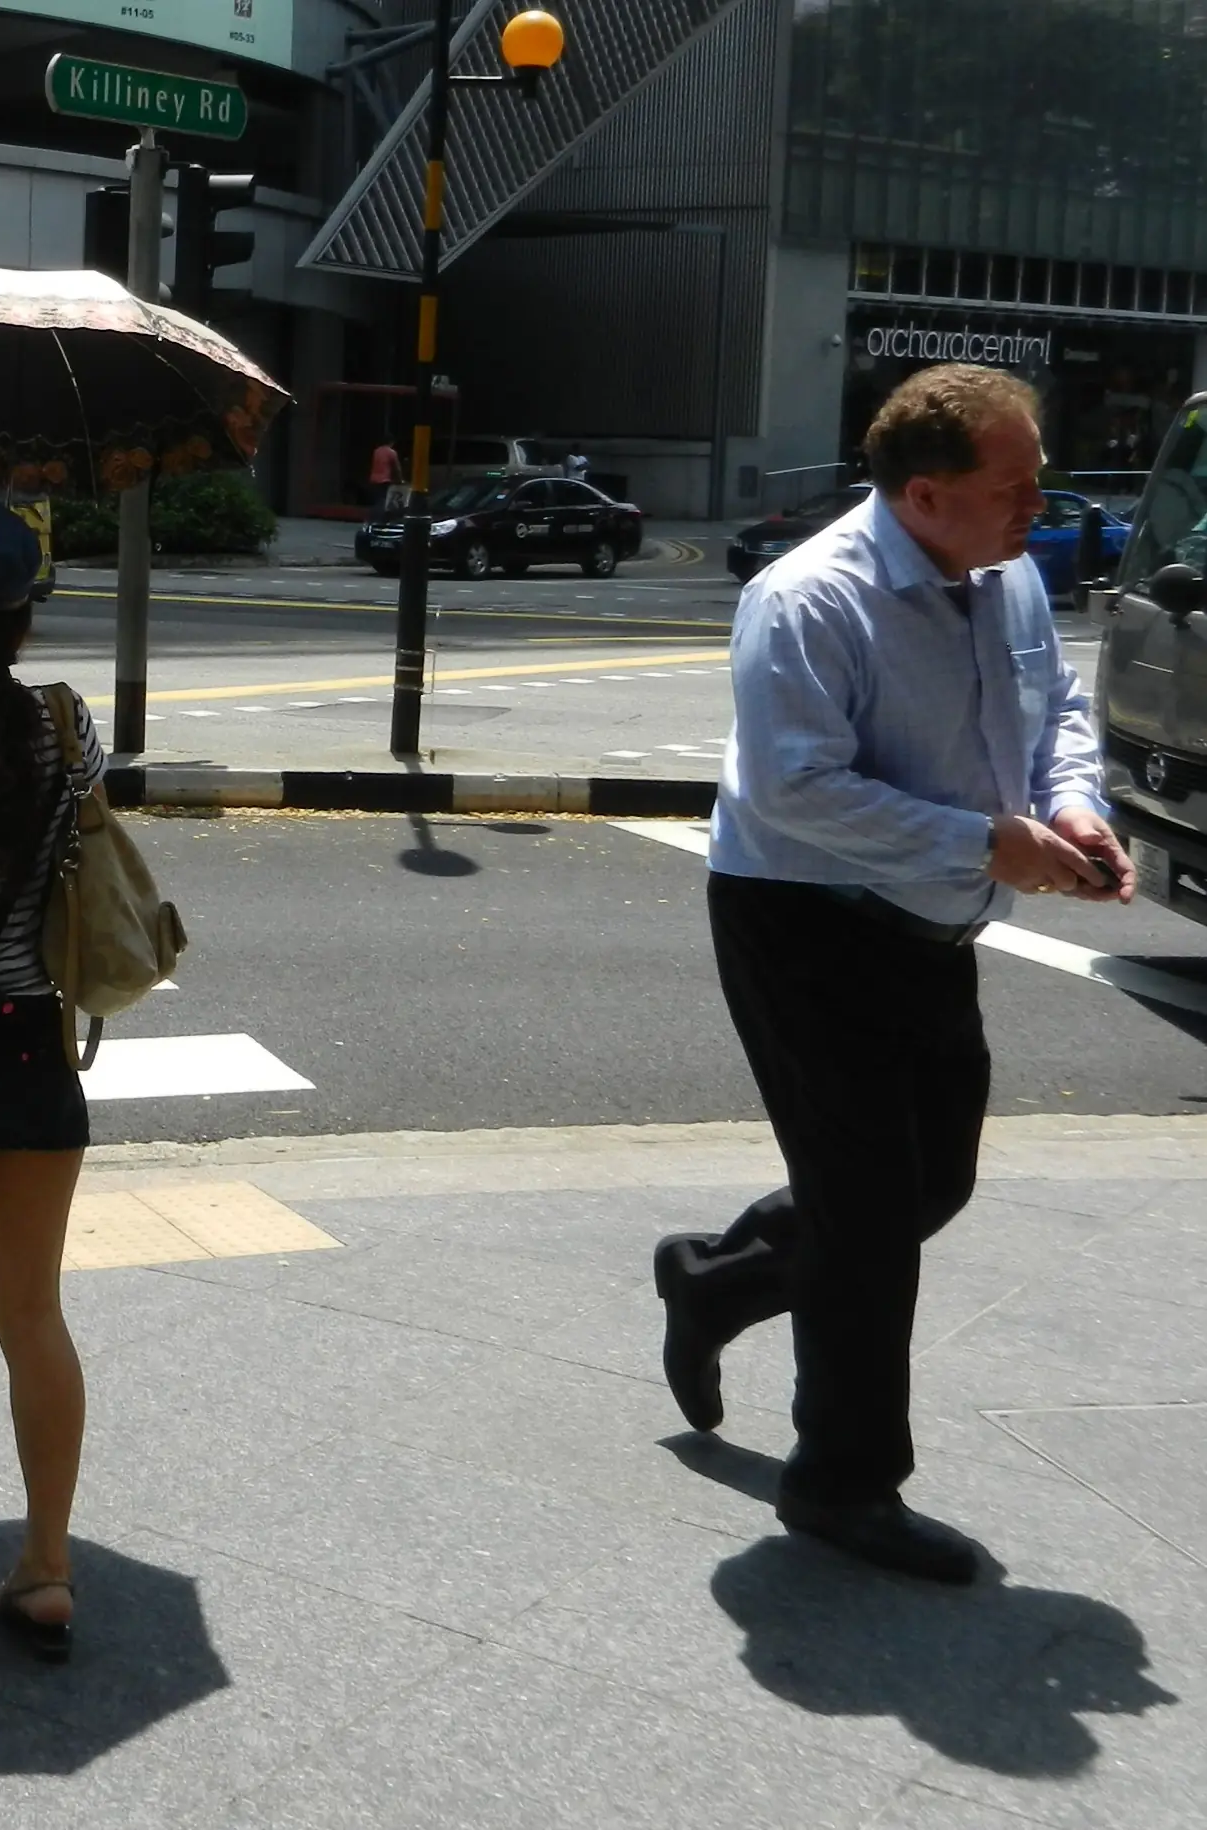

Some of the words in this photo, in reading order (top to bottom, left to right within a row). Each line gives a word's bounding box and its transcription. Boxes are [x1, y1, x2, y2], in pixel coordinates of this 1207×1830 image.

[120, 6, 155, 20] #11-05
[229, 31, 255, 44] #05-33
[70, 66, 185, 122] Killiney
[200, 89, 230, 122] Rd
[867, 320, 1051, 364] orchardcentral
